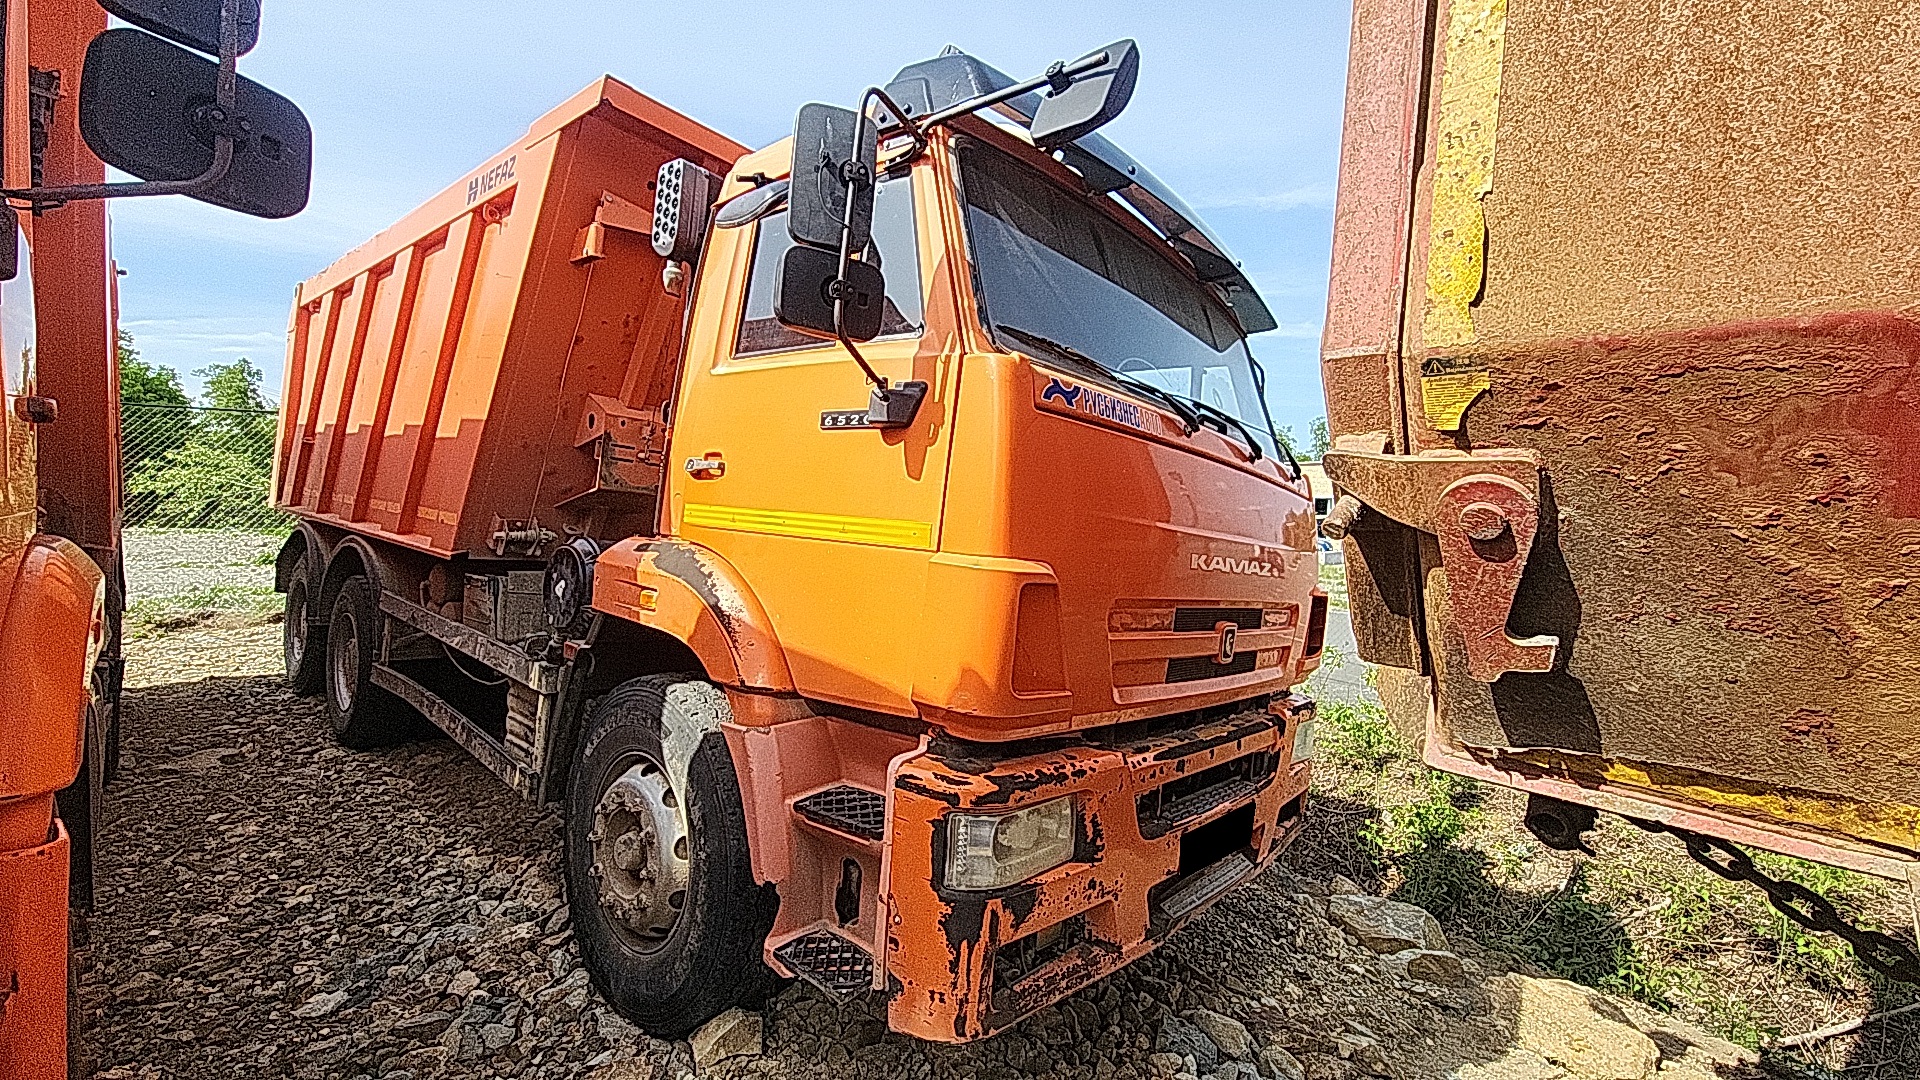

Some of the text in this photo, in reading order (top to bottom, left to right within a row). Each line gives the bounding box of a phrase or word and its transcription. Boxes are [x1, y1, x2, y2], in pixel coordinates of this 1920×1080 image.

[479, 155, 517, 195] NEFAZ
[1082, 387, 1162, 436] РУСБИЗНЕСАВТО
[1190, 553, 1272, 576] KAMAZ
